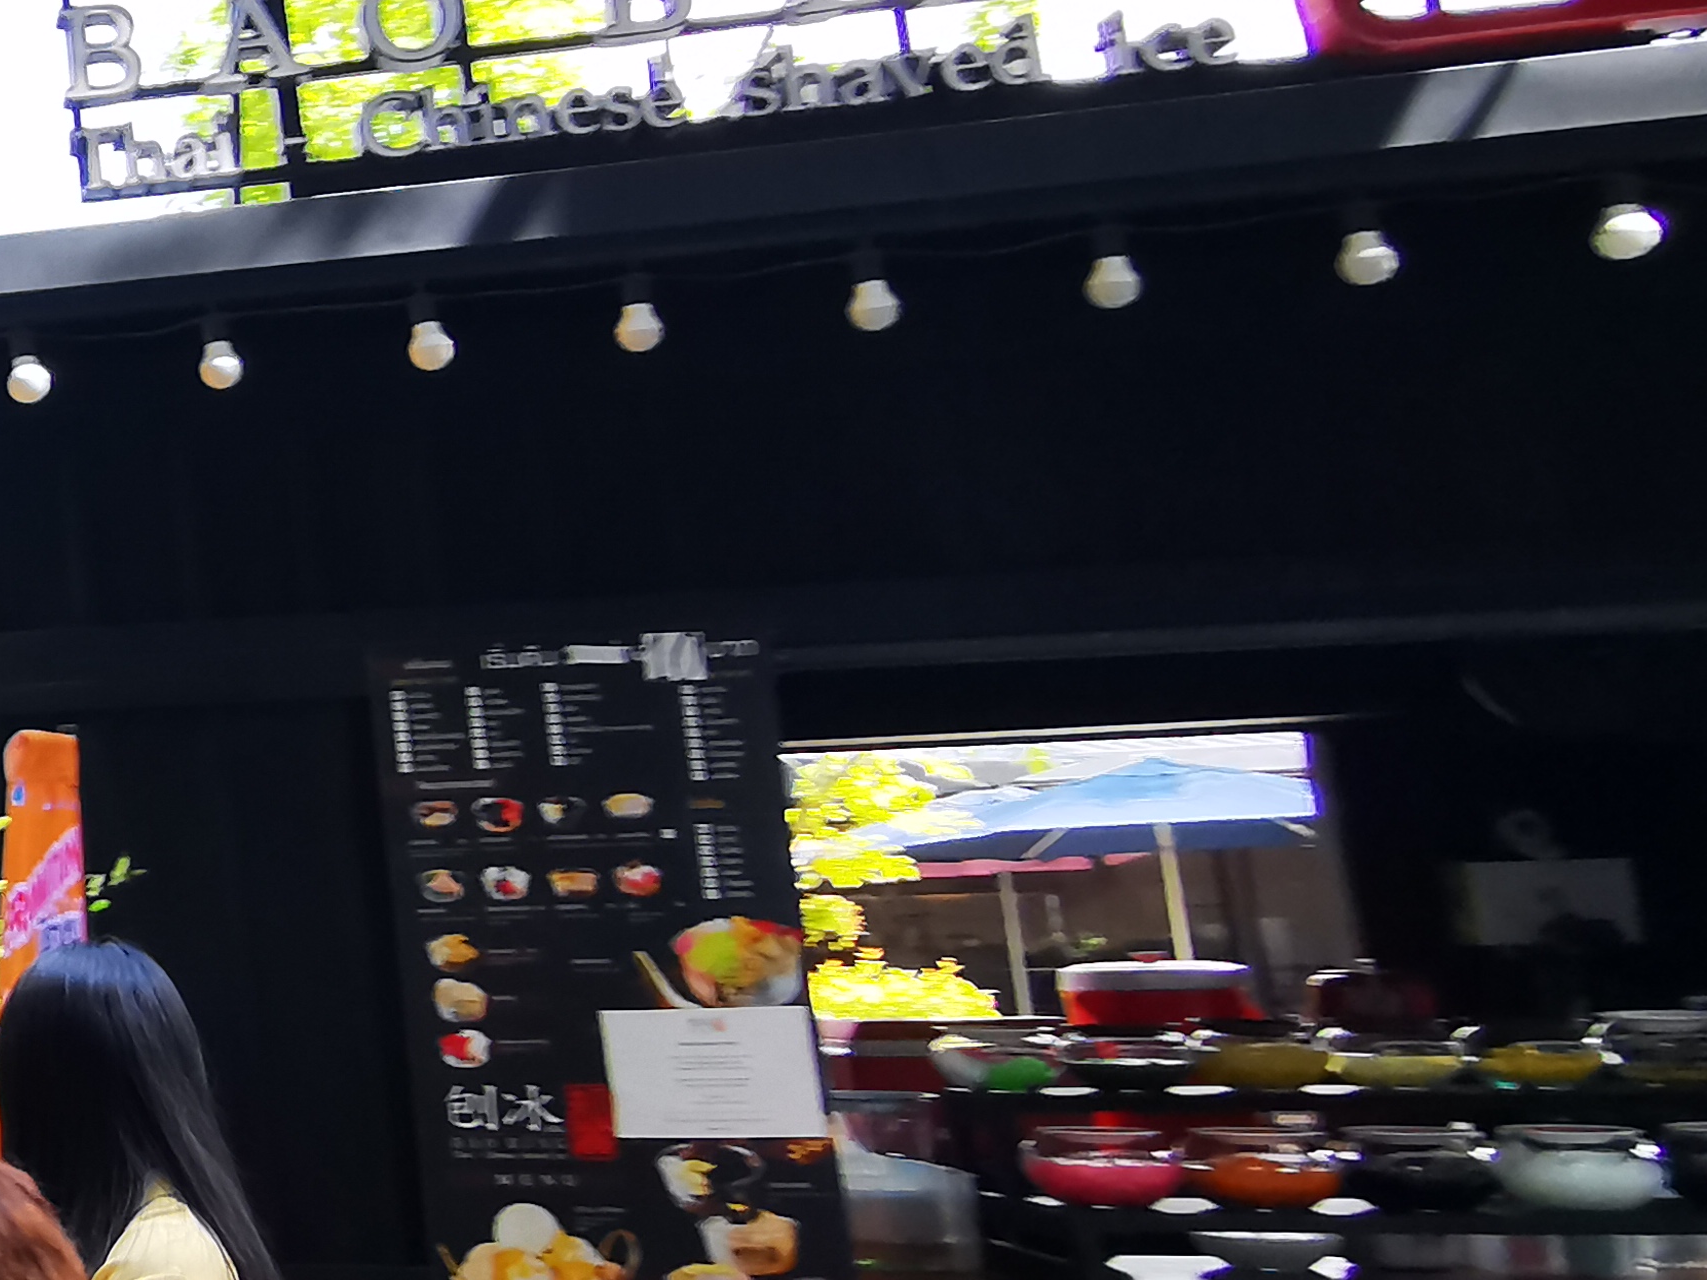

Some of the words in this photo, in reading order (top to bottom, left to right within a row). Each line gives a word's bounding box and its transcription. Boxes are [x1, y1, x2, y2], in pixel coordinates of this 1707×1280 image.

[75, 114, 239, 190] Thai
[359, 82, 687, 157] Chinese
[735, 16, 1051, 116] shaved
[1095, 10, 1238, 78] ice
